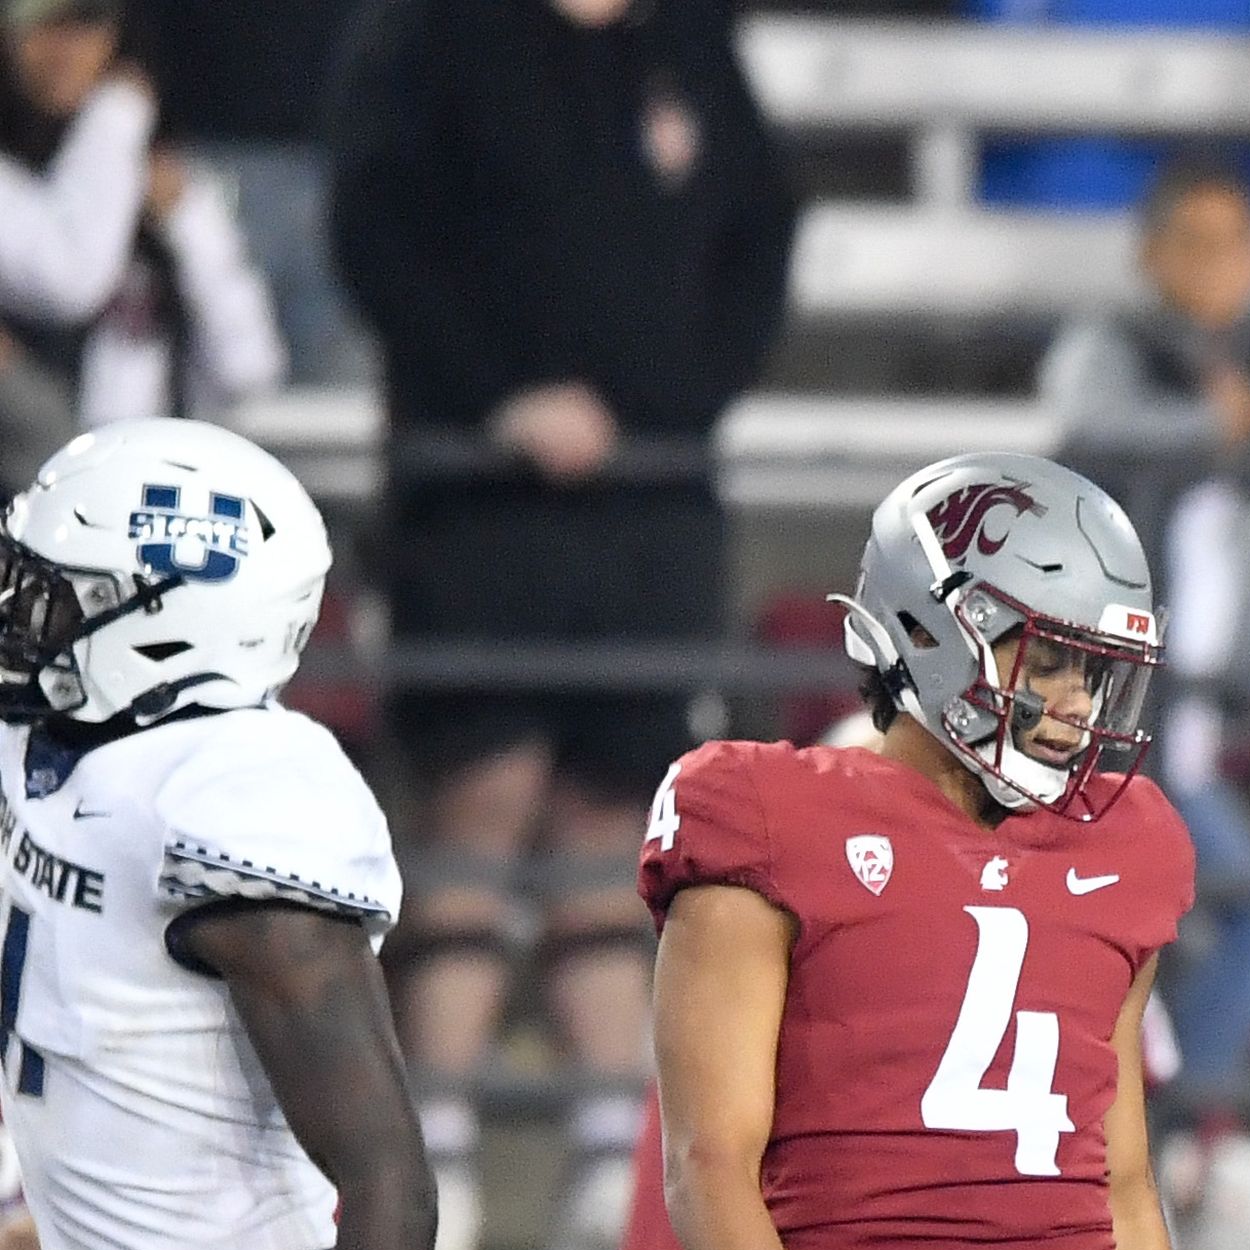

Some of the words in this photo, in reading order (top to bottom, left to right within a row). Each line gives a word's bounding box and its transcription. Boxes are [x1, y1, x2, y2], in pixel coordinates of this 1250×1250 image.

[646, 763, 681, 853] 4
[13, 829, 105, 914] STATE
[921, 905, 1077, 1177] 4
